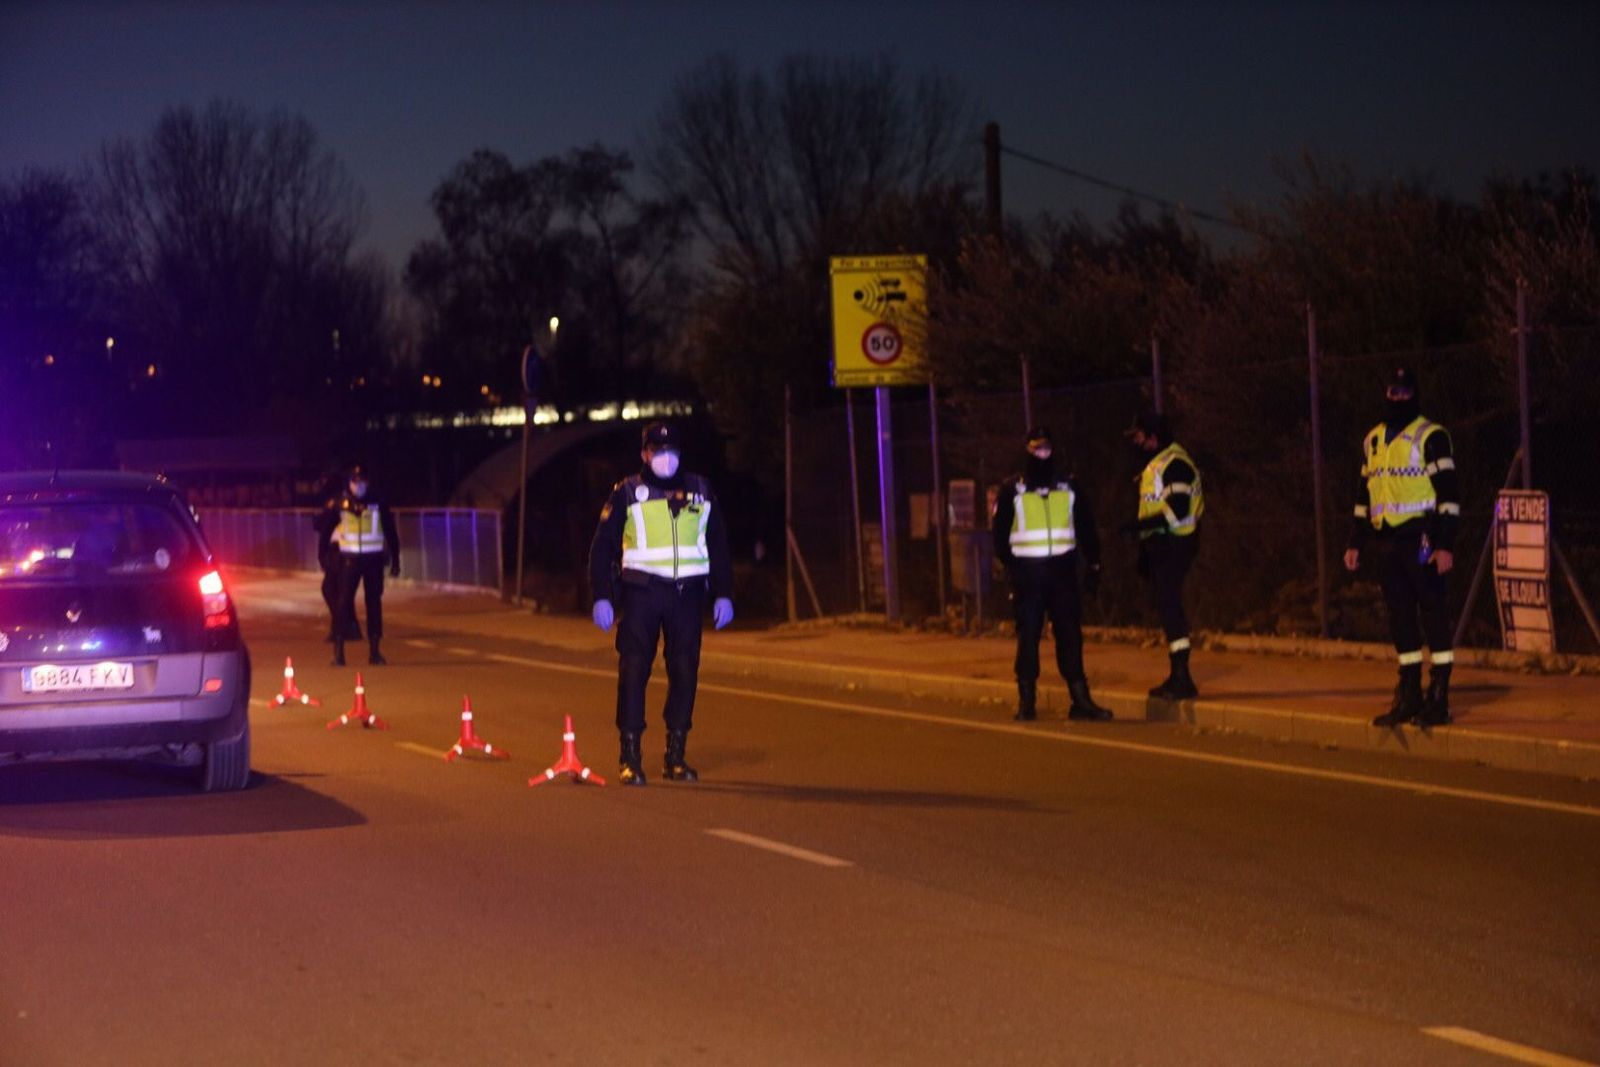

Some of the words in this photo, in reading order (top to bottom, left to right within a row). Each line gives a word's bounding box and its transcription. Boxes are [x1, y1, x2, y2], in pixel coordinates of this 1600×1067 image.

[871, 336, 894, 351] 50
[1498, 497, 1509, 521] SE
[1512, 497, 1545, 521] VENDE
